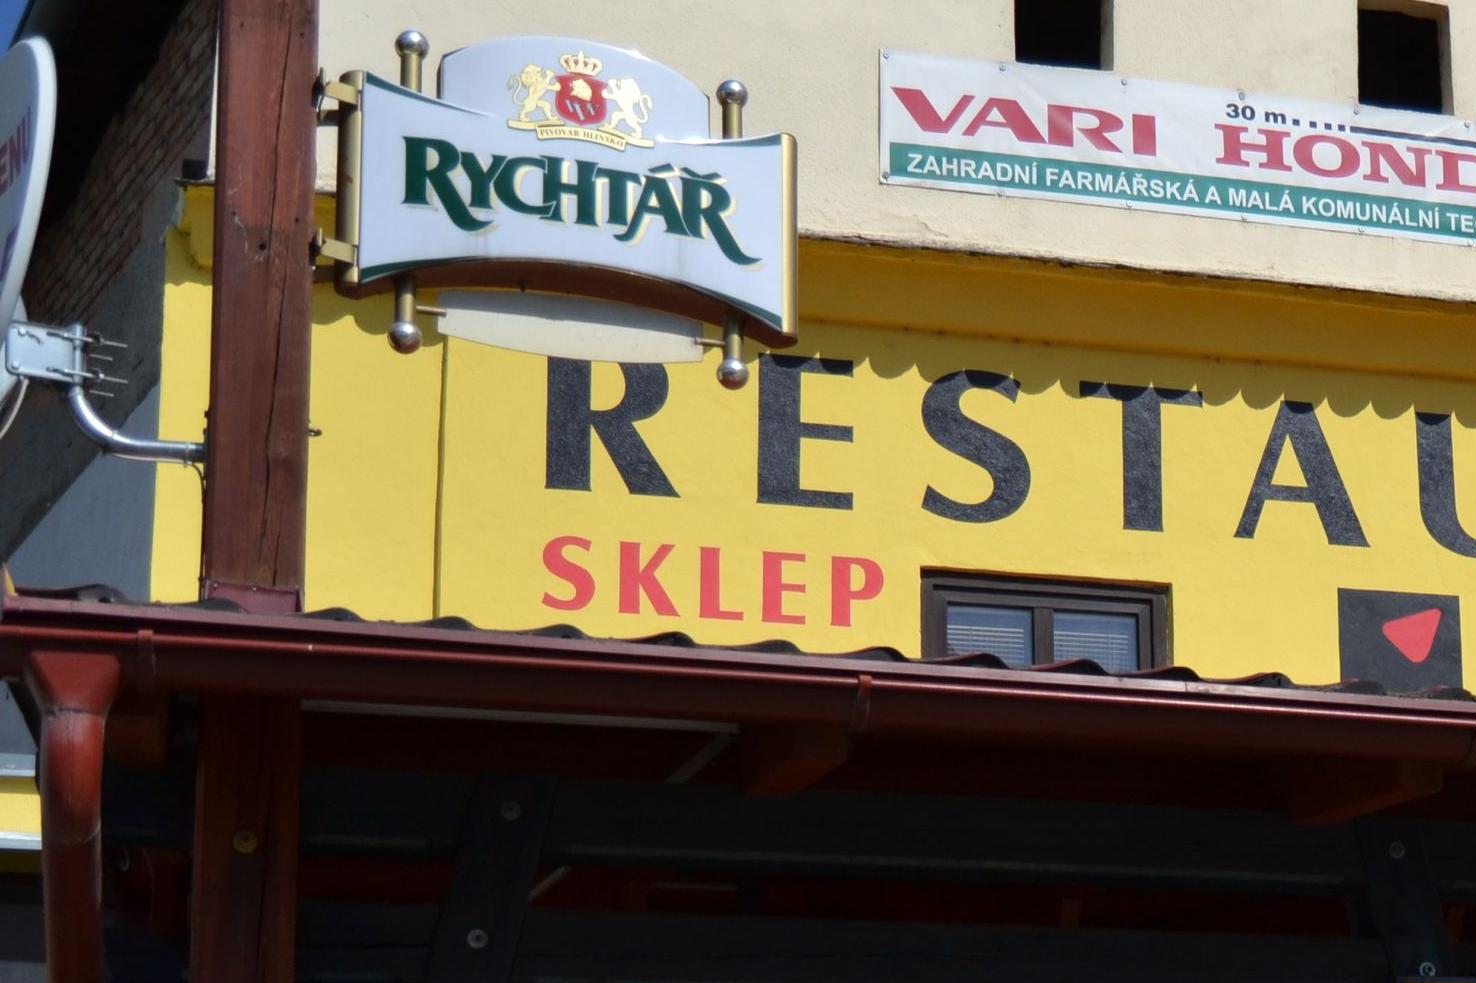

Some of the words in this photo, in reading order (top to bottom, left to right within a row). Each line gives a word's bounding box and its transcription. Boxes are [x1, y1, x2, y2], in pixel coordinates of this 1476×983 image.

[540, 128, 579, 139] PIVOVAR
[583, 130, 624, 148] HLINSKO
[890, 86, 1156, 156] VARI
[1225, 103, 1256, 121] 30
[1265, 110, 1287, 125] m
[402, 136, 763, 266] RYCHTÁŘ
[907, 153, 1038, 186] ZAHRADNÍ
[1046, 168, 1199, 202] FARMÁŘSKÁ
[1204, 189, 1221, 206] A
[1229, 190, 1294, 213] MALÁ
[1302, 197, 1440, 229] KOMUNÁLNÍ
[542, 536, 885, 627] SKLEP
